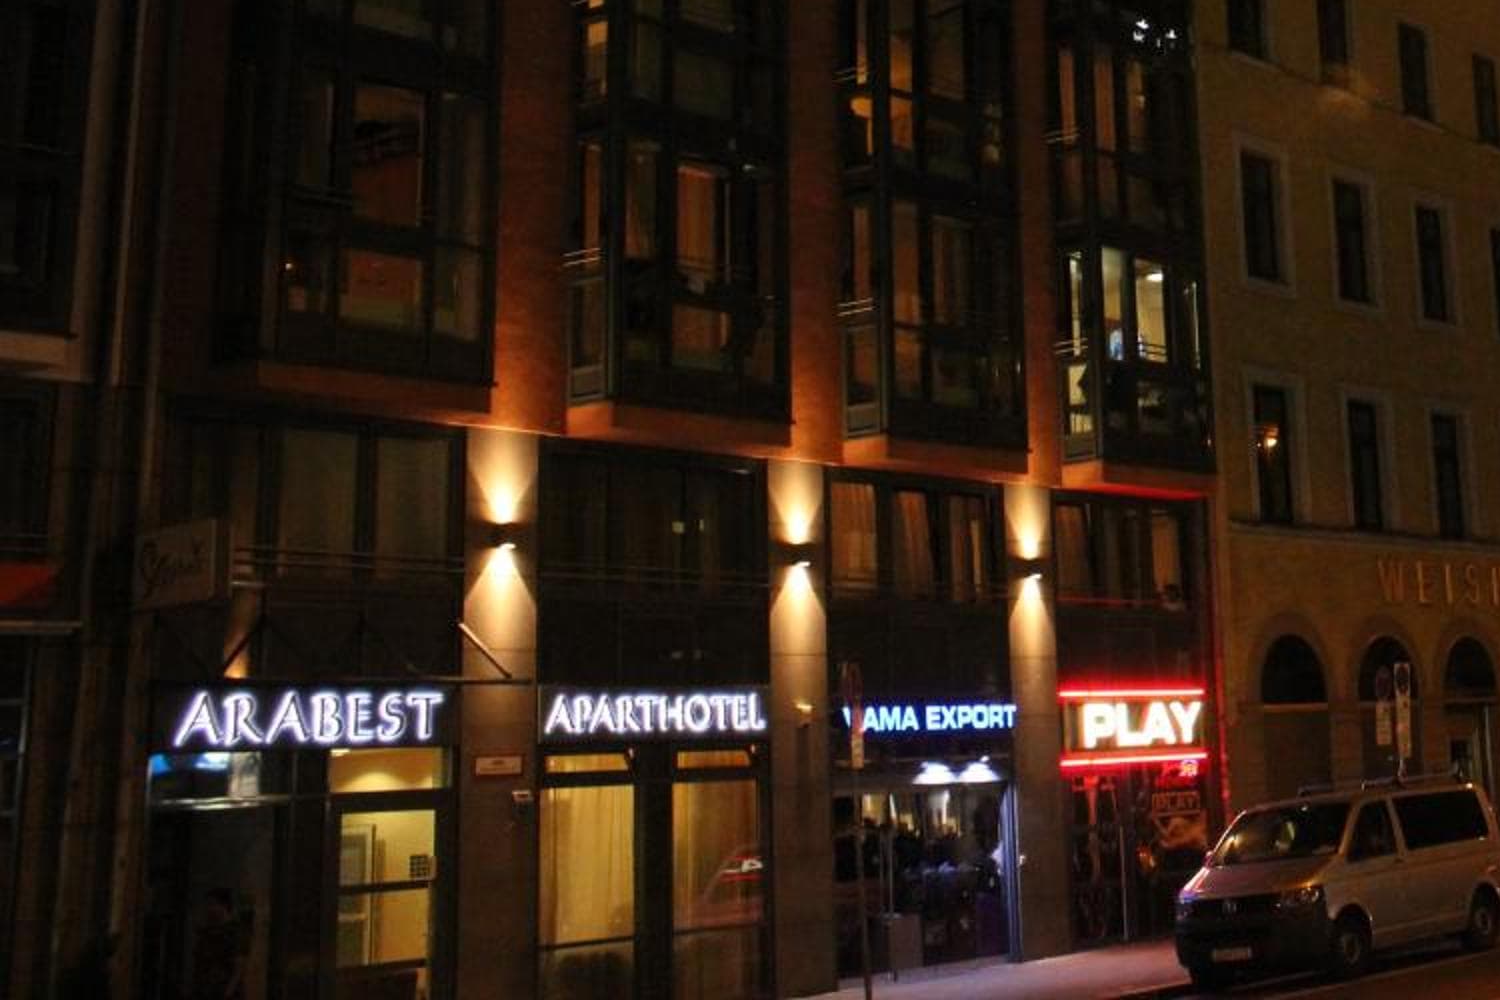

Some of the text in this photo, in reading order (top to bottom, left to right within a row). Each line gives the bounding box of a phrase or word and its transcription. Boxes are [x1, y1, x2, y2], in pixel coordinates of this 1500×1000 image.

[173, 690, 445, 746] ARABEST
[543, 692, 767, 734] APARTHOTEL
[924, 703, 1018, 731] EXPORT
[1081, 700, 1202, 748] PLAY
